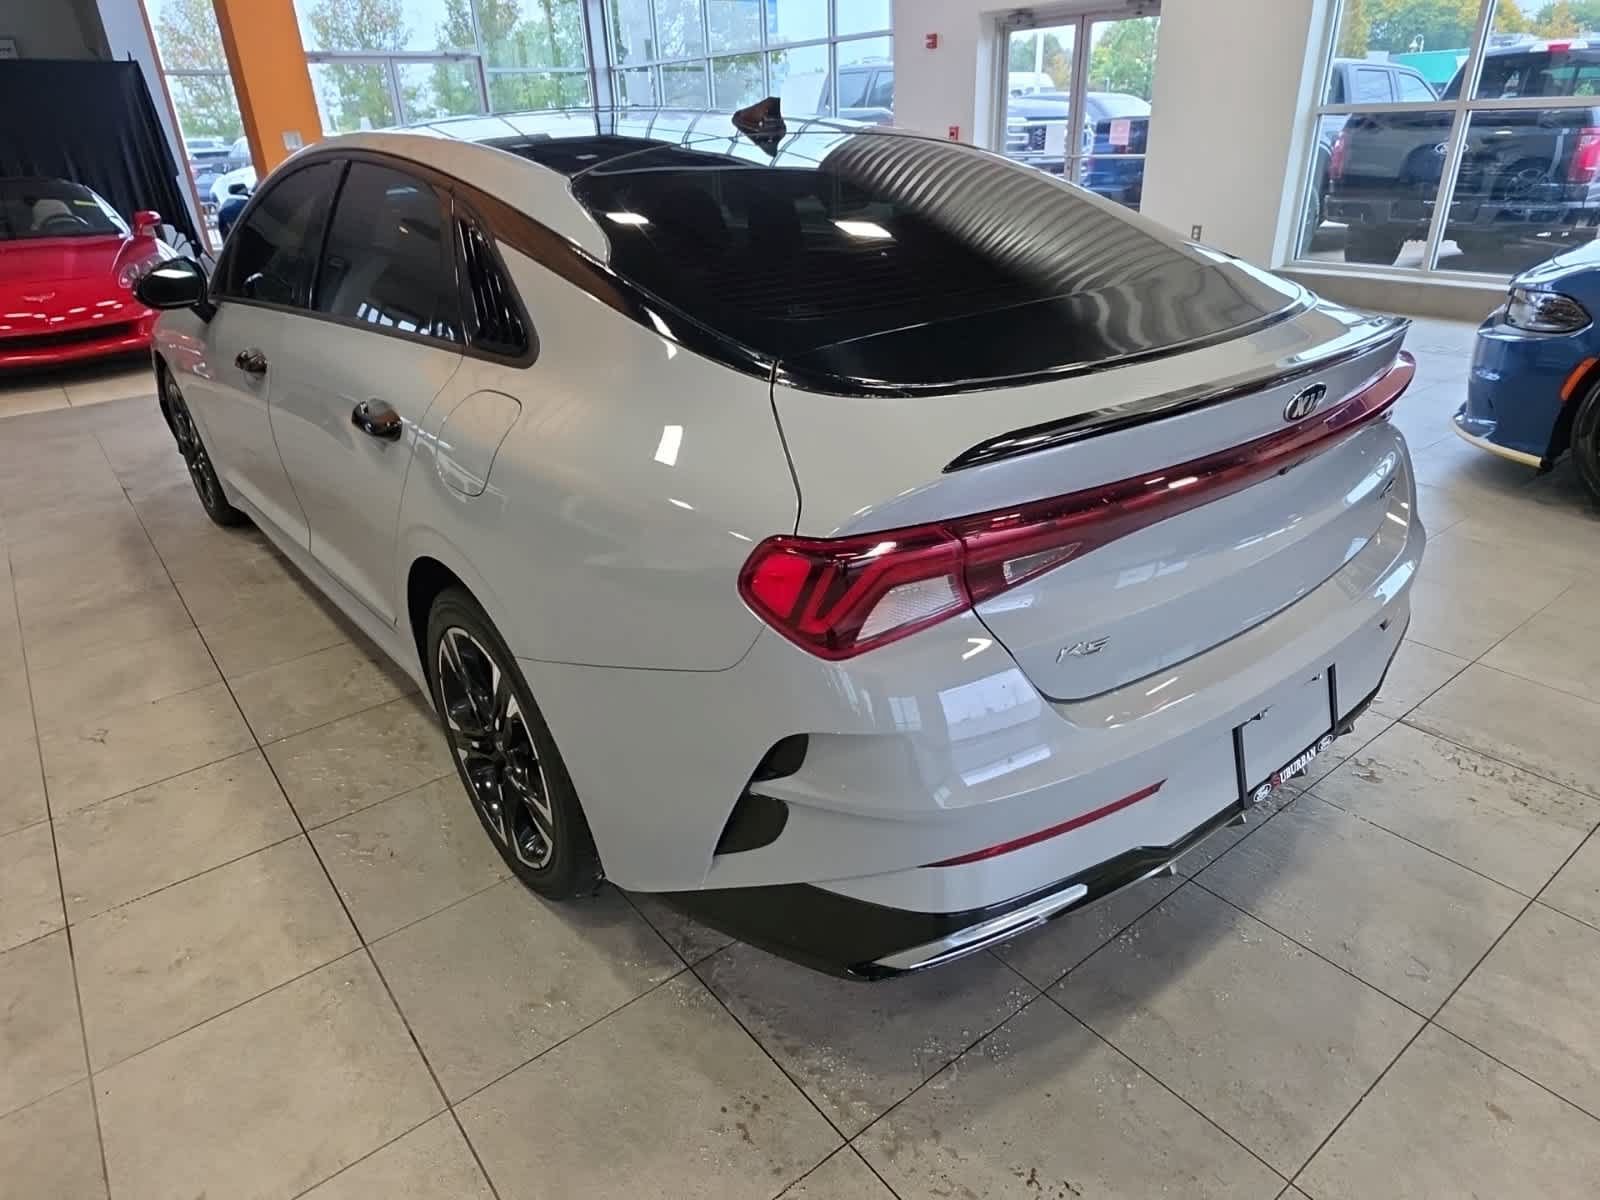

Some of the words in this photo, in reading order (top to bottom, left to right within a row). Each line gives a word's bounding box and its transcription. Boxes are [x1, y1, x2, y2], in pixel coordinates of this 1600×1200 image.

[1291, 389, 1324, 418] KIA
[1056, 636, 1110, 664] K5
[1271, 746, 1317, 786] SUBURBAN
